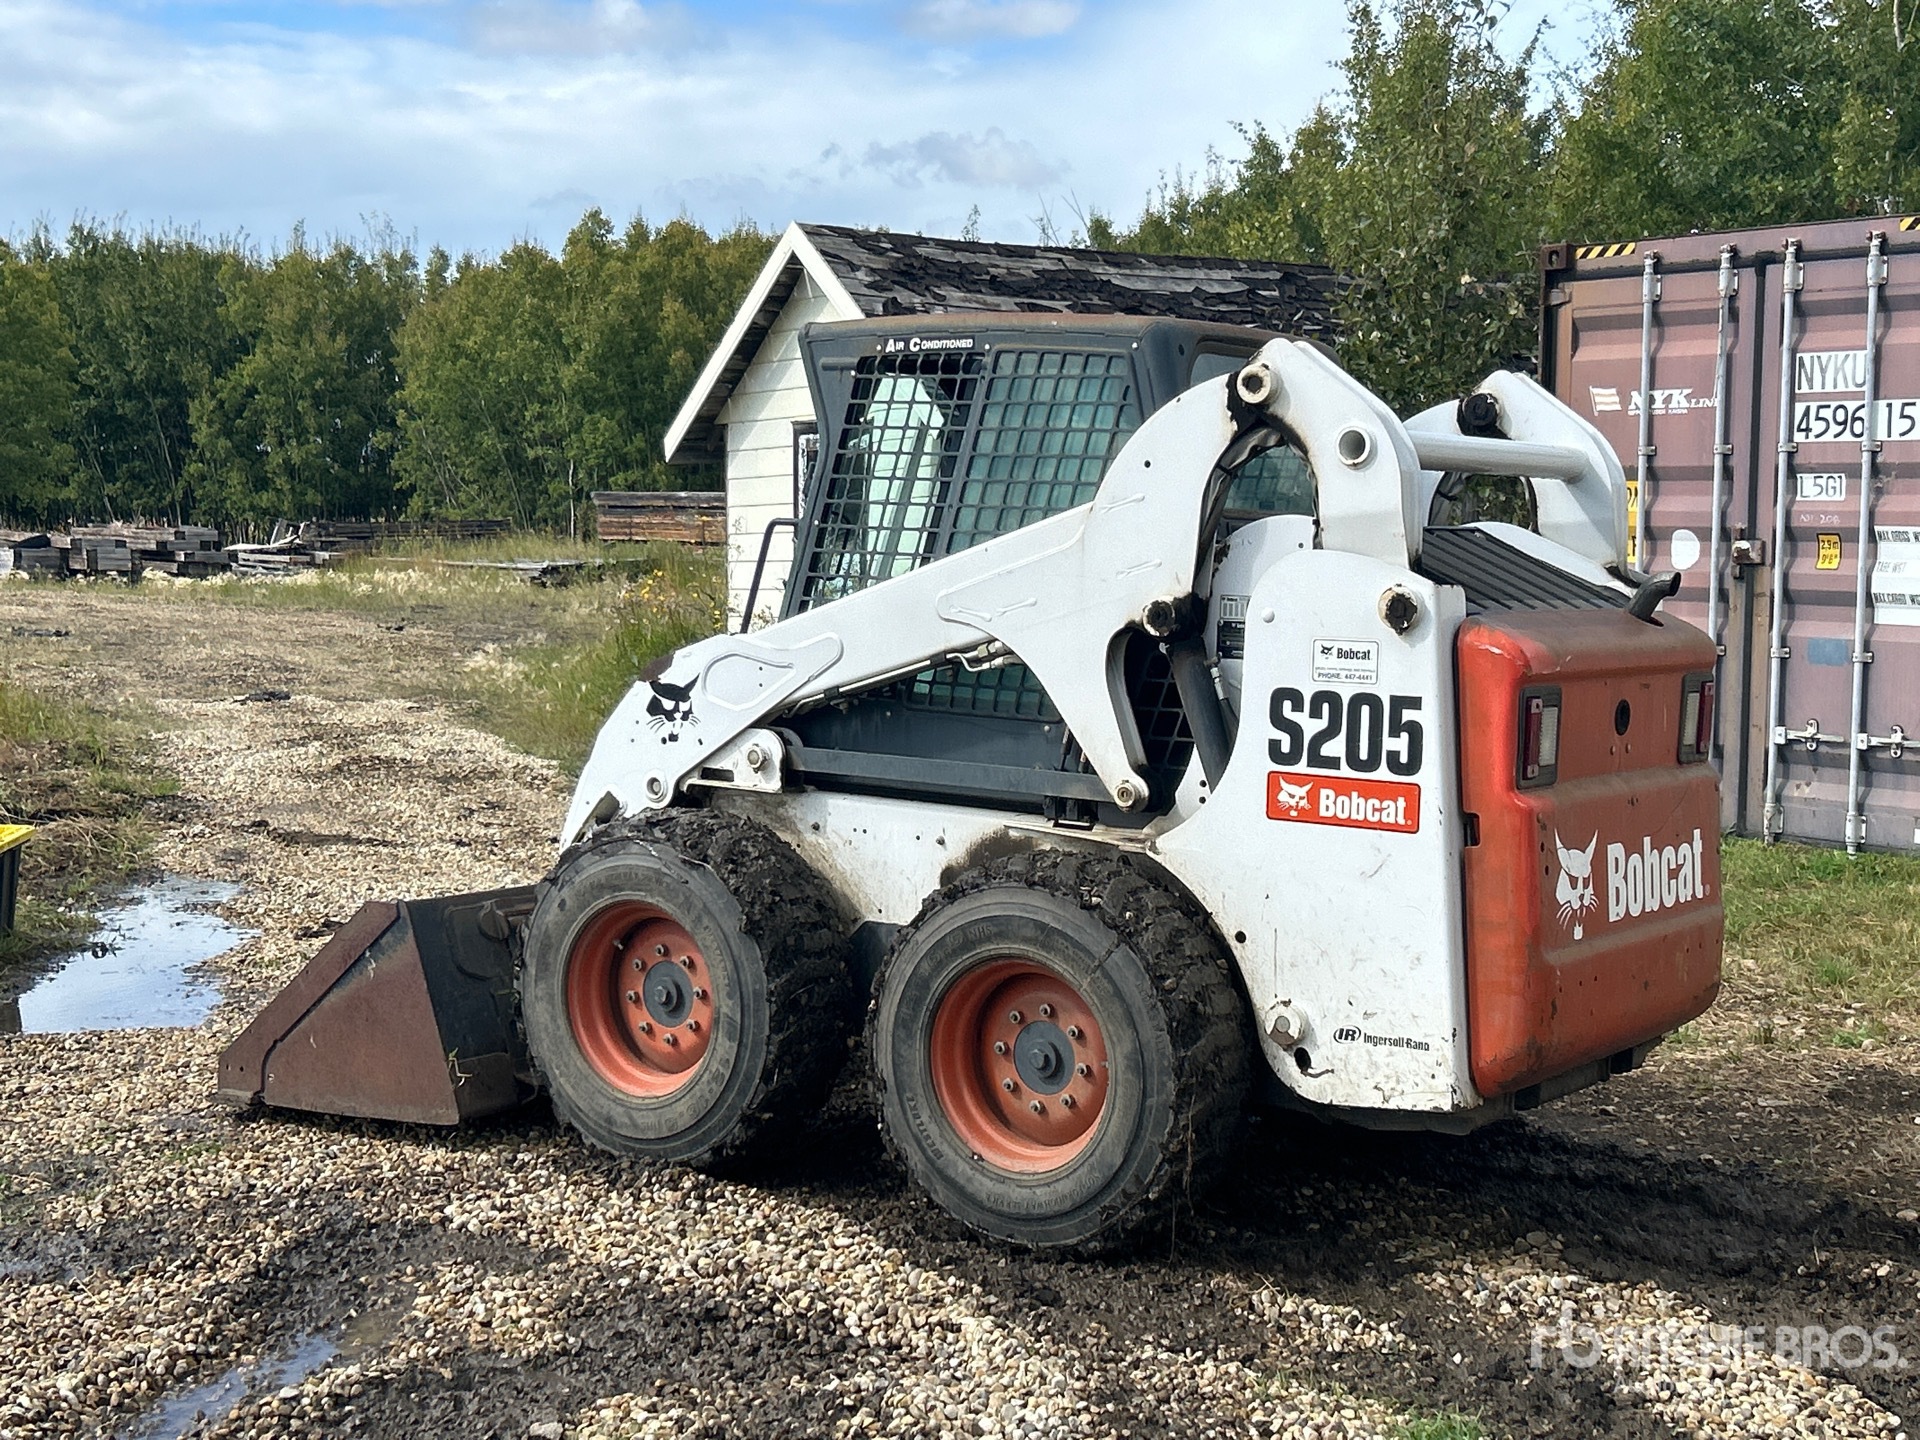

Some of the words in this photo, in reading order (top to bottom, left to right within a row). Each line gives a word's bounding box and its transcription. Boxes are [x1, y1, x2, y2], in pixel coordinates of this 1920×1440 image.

[885, 338, 905, 353] AIR
[909, 337, 974, 352] CONDITIONED
[1797, 353, 1867, 391] NYKU
[1800, 475, 1843, 498] L5G1
[1336, 647, 1371, 661] Bobcat
[1267, 687, 1424, 777] S205
[1318, 787, 1406, 826] Bobcat
[1606, 827, 1704, 923] Bobcat
